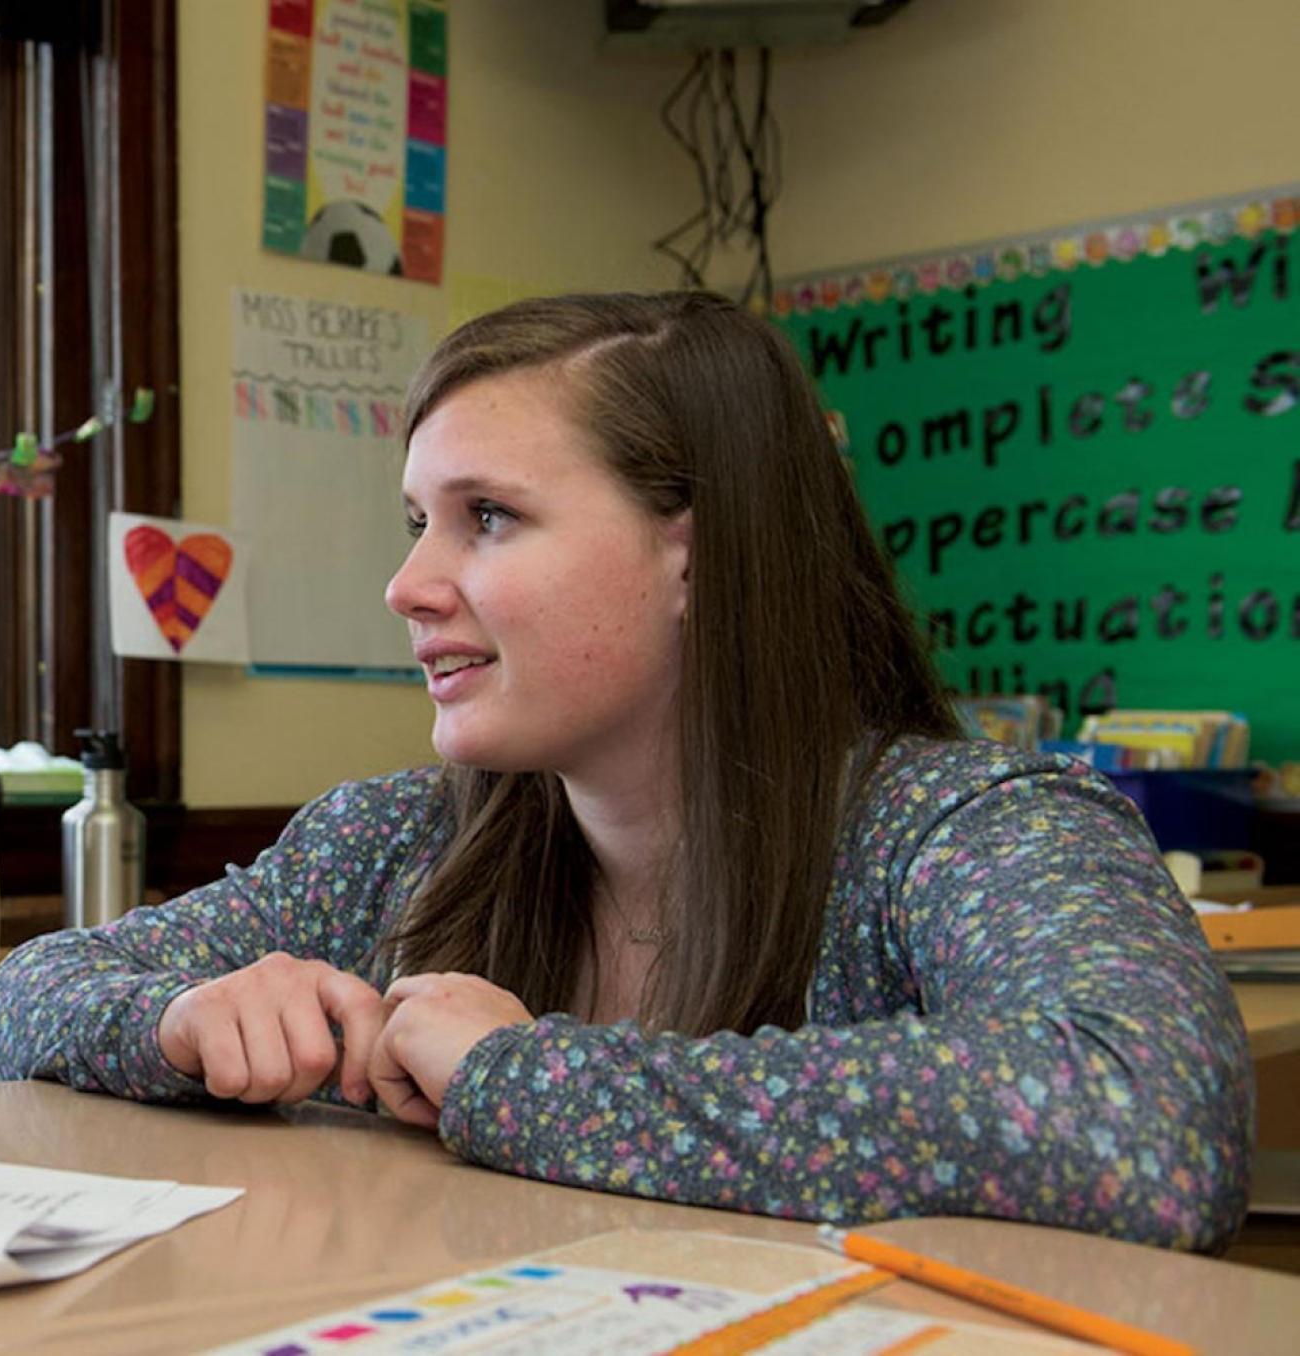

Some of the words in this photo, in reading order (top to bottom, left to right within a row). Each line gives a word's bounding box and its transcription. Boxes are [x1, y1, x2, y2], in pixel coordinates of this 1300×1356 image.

[241, 292, 297, 335] MISS
[282, 338, 382, 374] TALLIES
[807, 283, 1073, 379] Writing
[877, 369, 1211, 467] omplete
[883, 485, 1242, 576] ppercase
[926, 571, 1300, 650] nctuatio
